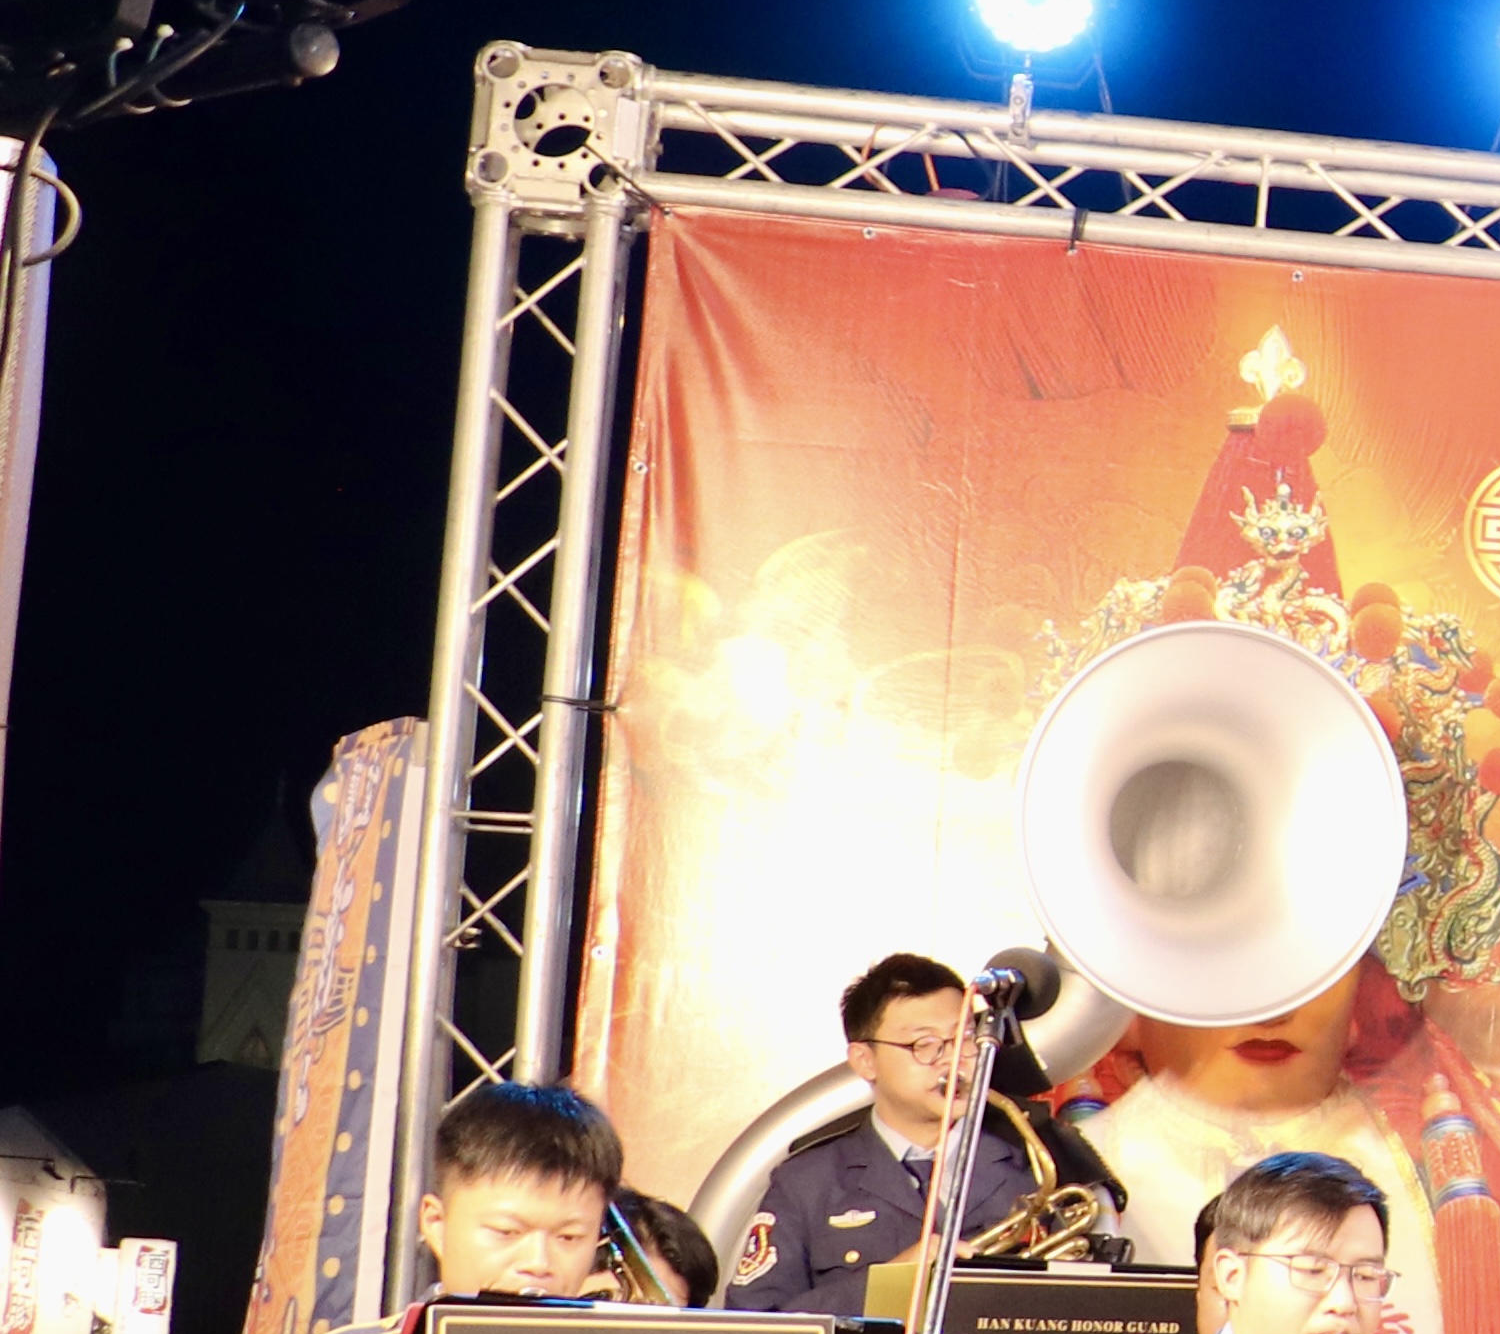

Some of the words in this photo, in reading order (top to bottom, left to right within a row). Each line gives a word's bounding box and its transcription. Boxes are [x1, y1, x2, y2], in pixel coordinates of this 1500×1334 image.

[976, 1317, 1011, 1330] HAN
[1013, 1318, 1068, 1332] KUANG
[1071, 1320, 1123, 1333] HONOR
[1126, 1321, 1180, 1334] GUARD
